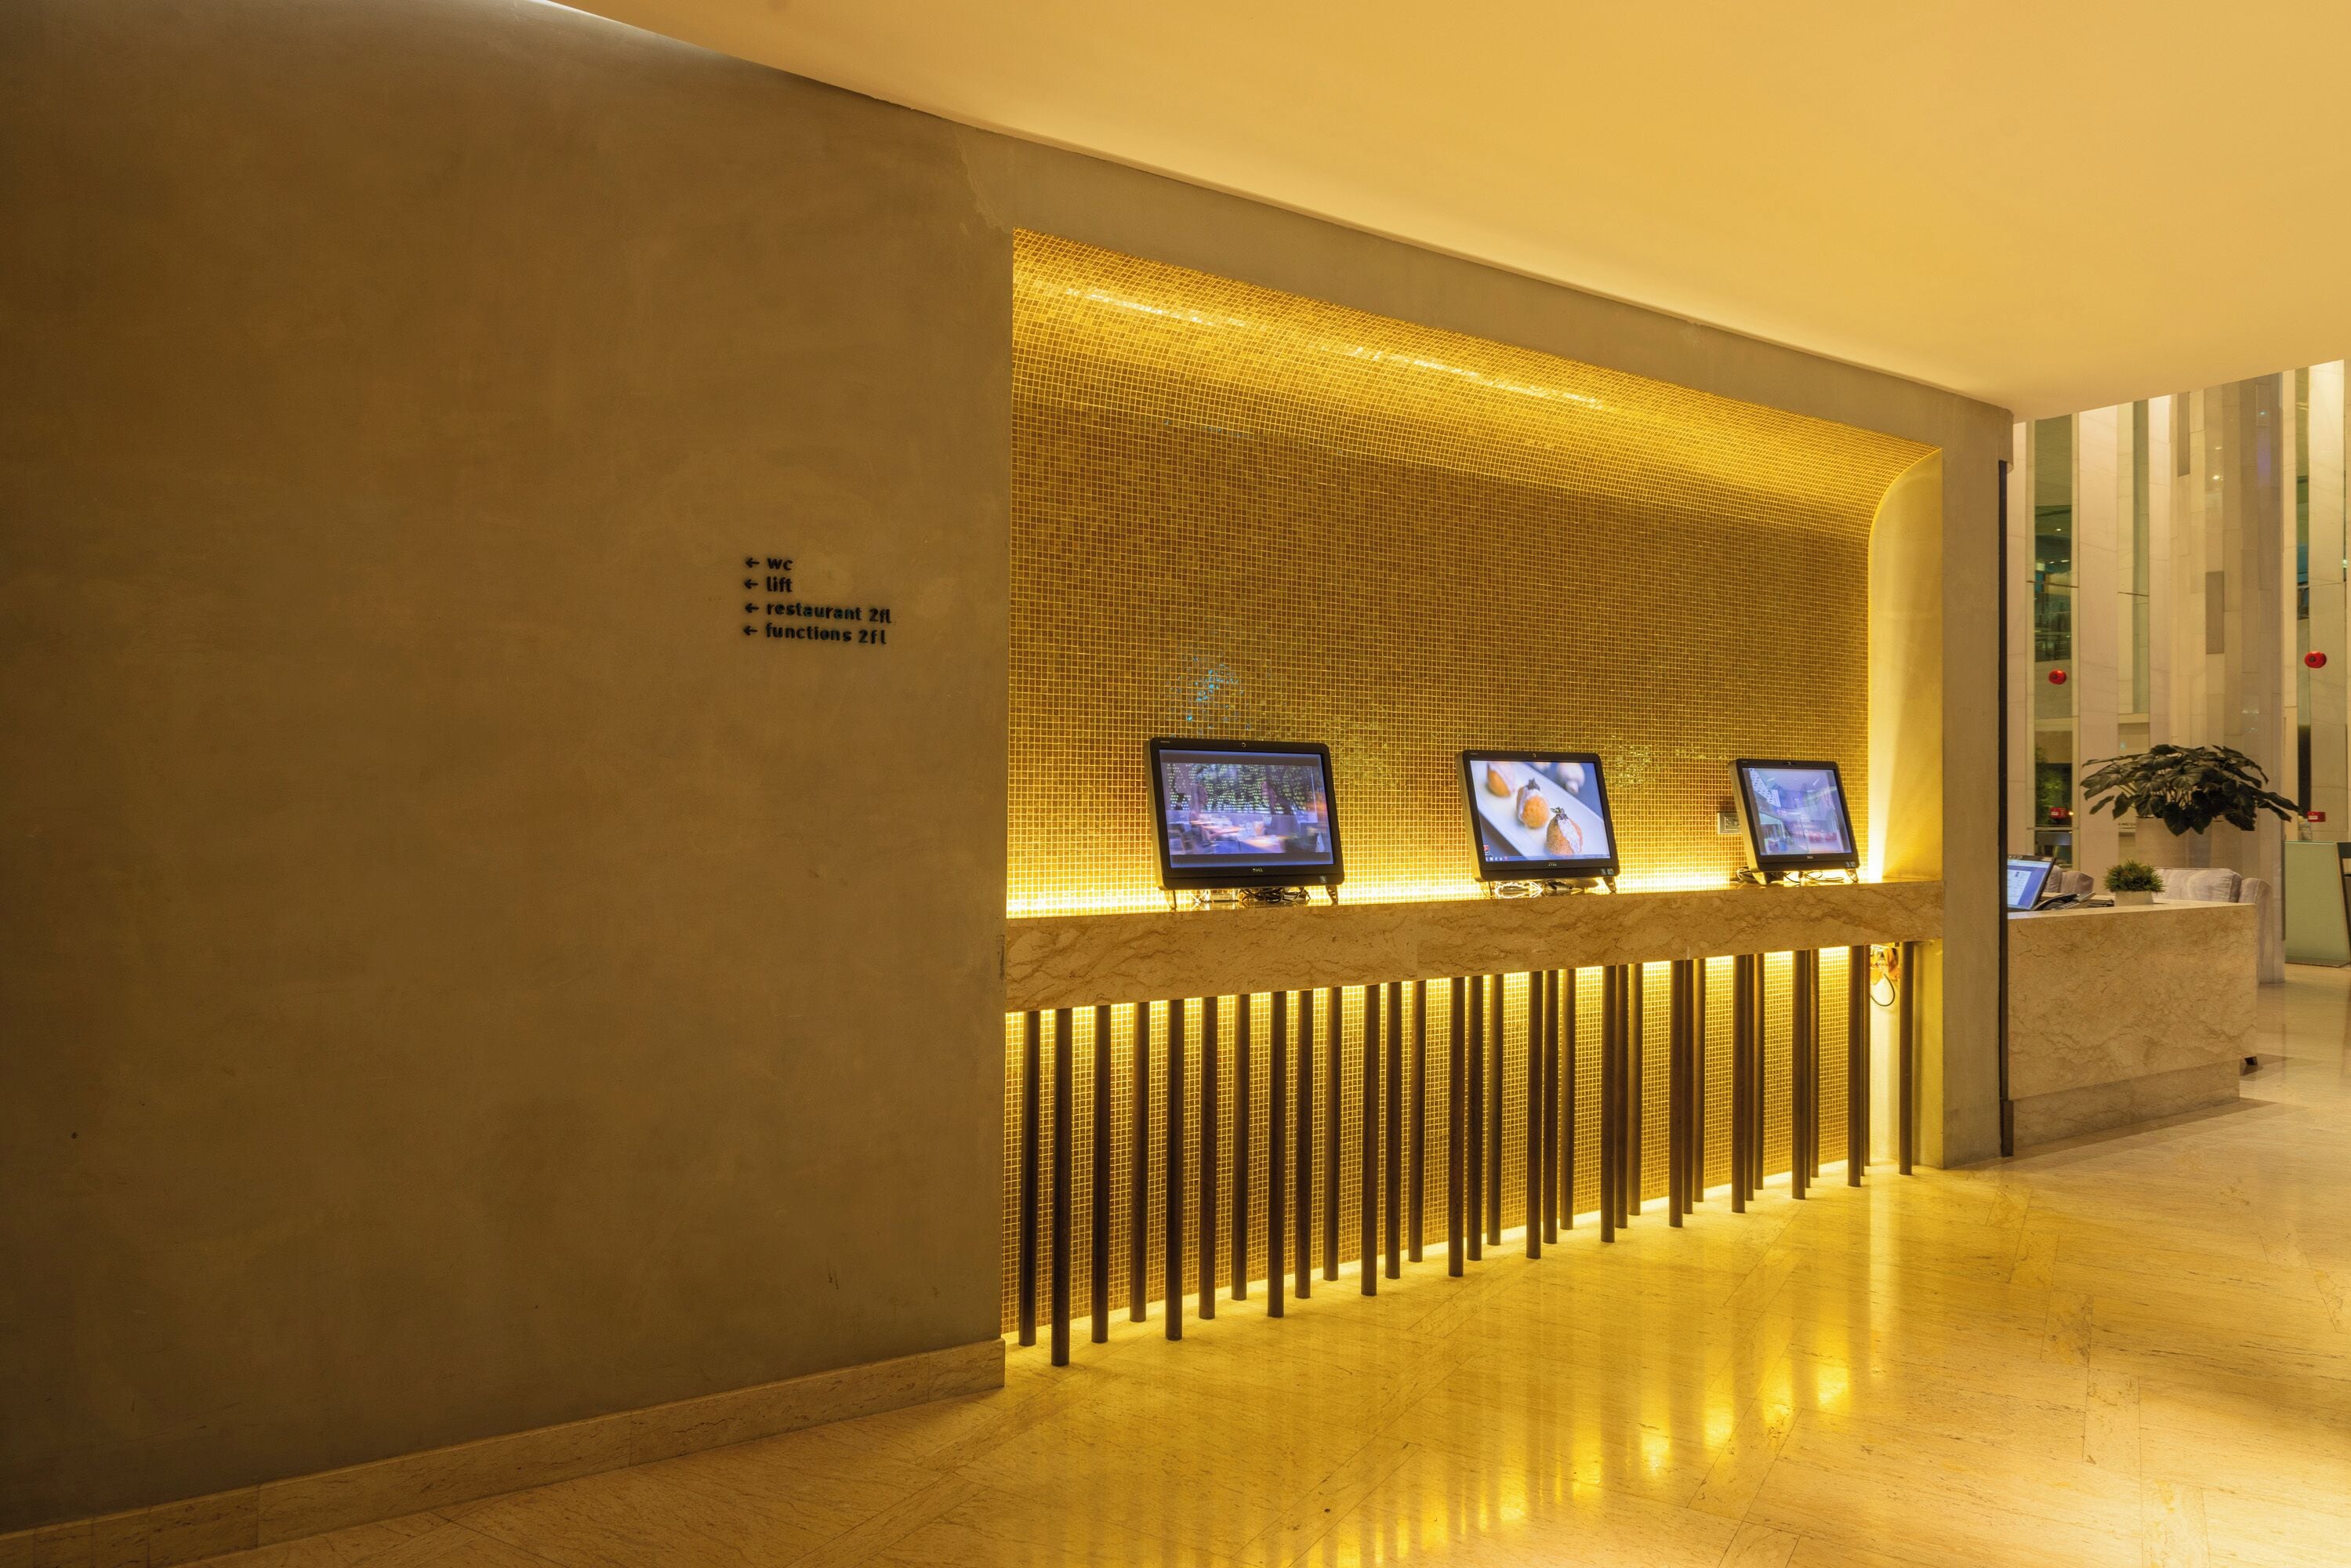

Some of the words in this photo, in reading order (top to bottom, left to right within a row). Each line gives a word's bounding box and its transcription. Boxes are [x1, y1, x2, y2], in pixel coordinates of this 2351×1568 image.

[767, 557, 793, 571] wc
[766, 576, 793, 593] lift
[767, 603, 862, 621] restaurant
[869, 608, 892, 624] 2fl
[766, 622, 852, 642] functions
[858, 630, 887, 644] 2fl
